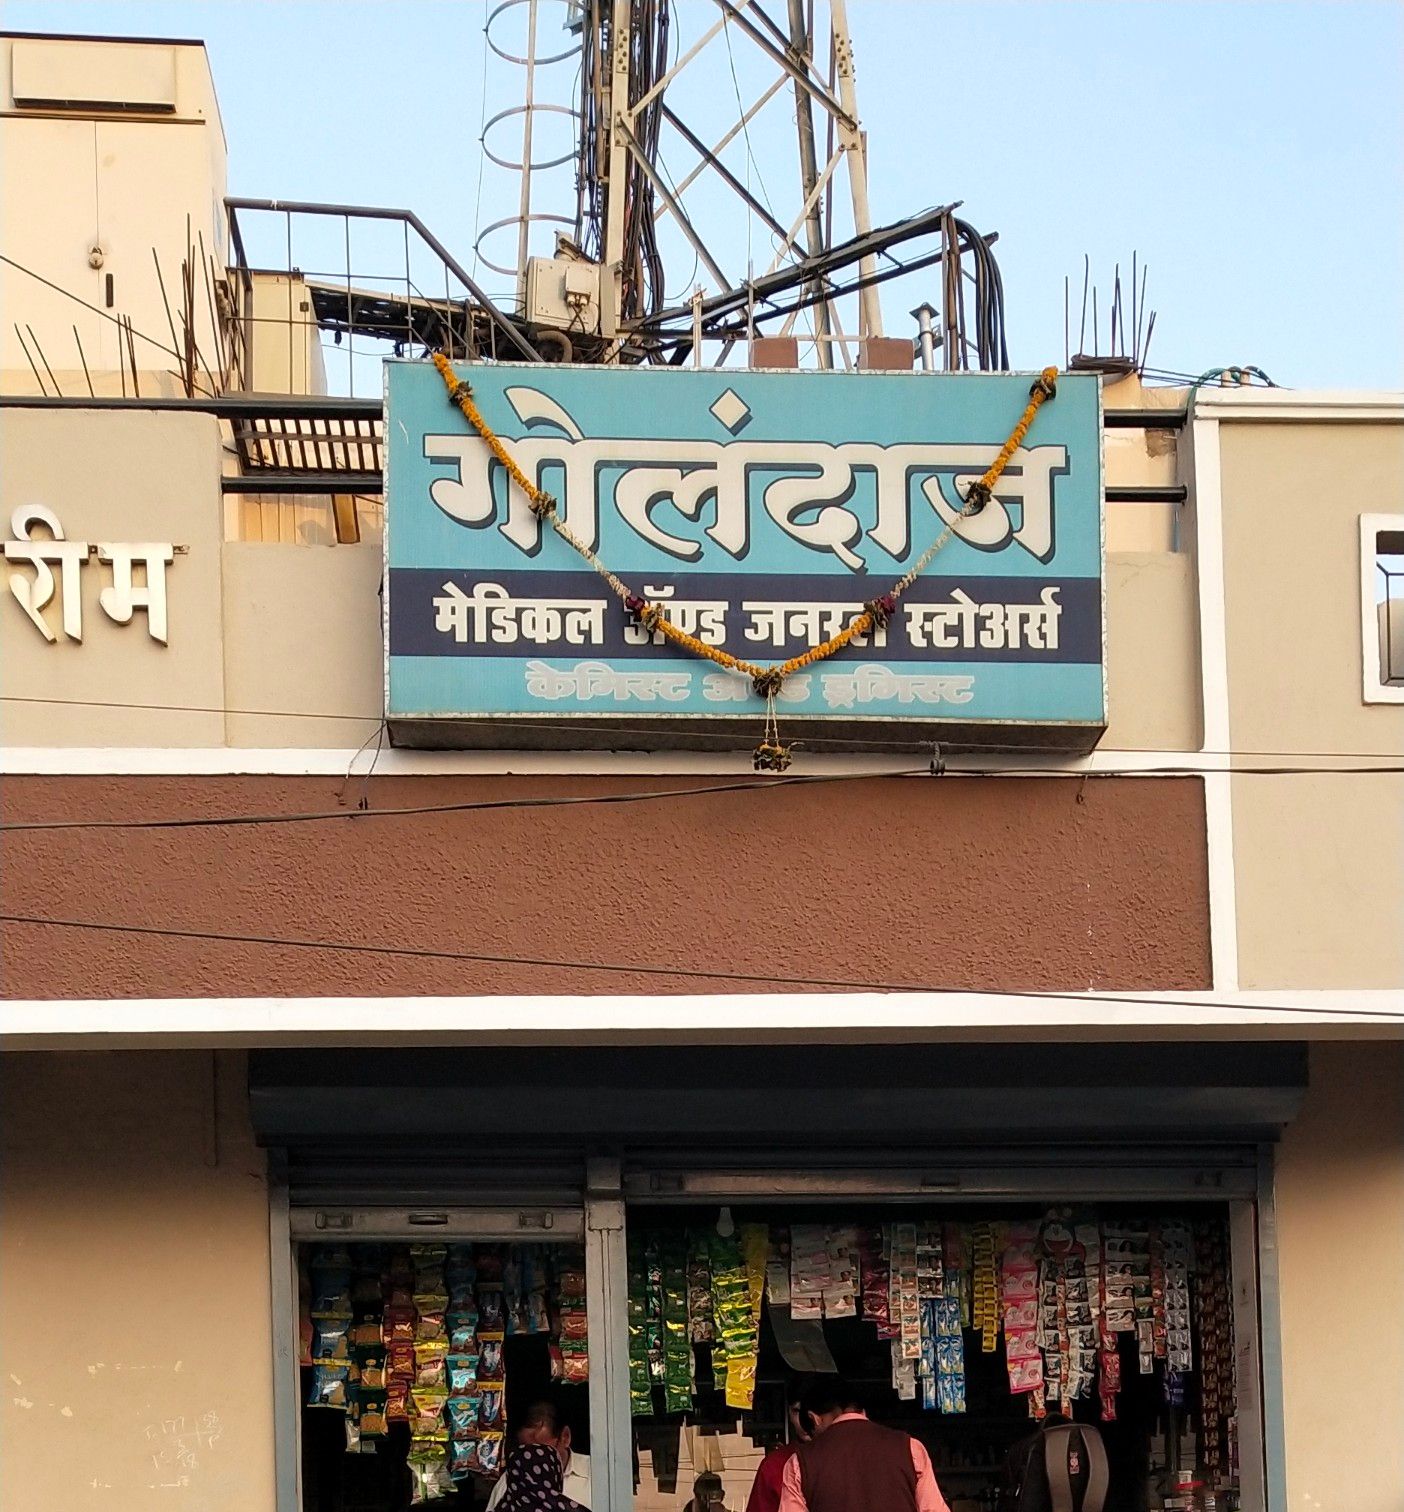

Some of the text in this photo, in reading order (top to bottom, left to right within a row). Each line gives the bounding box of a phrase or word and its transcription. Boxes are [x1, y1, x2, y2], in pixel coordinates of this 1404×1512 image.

[424, 384, 1070, 575] गोलंदाज
[433, 581, 607, 645] मेडिकल
[904, 587, 1062, 650] स्टोअर्स
[525, 660, 692, 701] केमिस्ट
